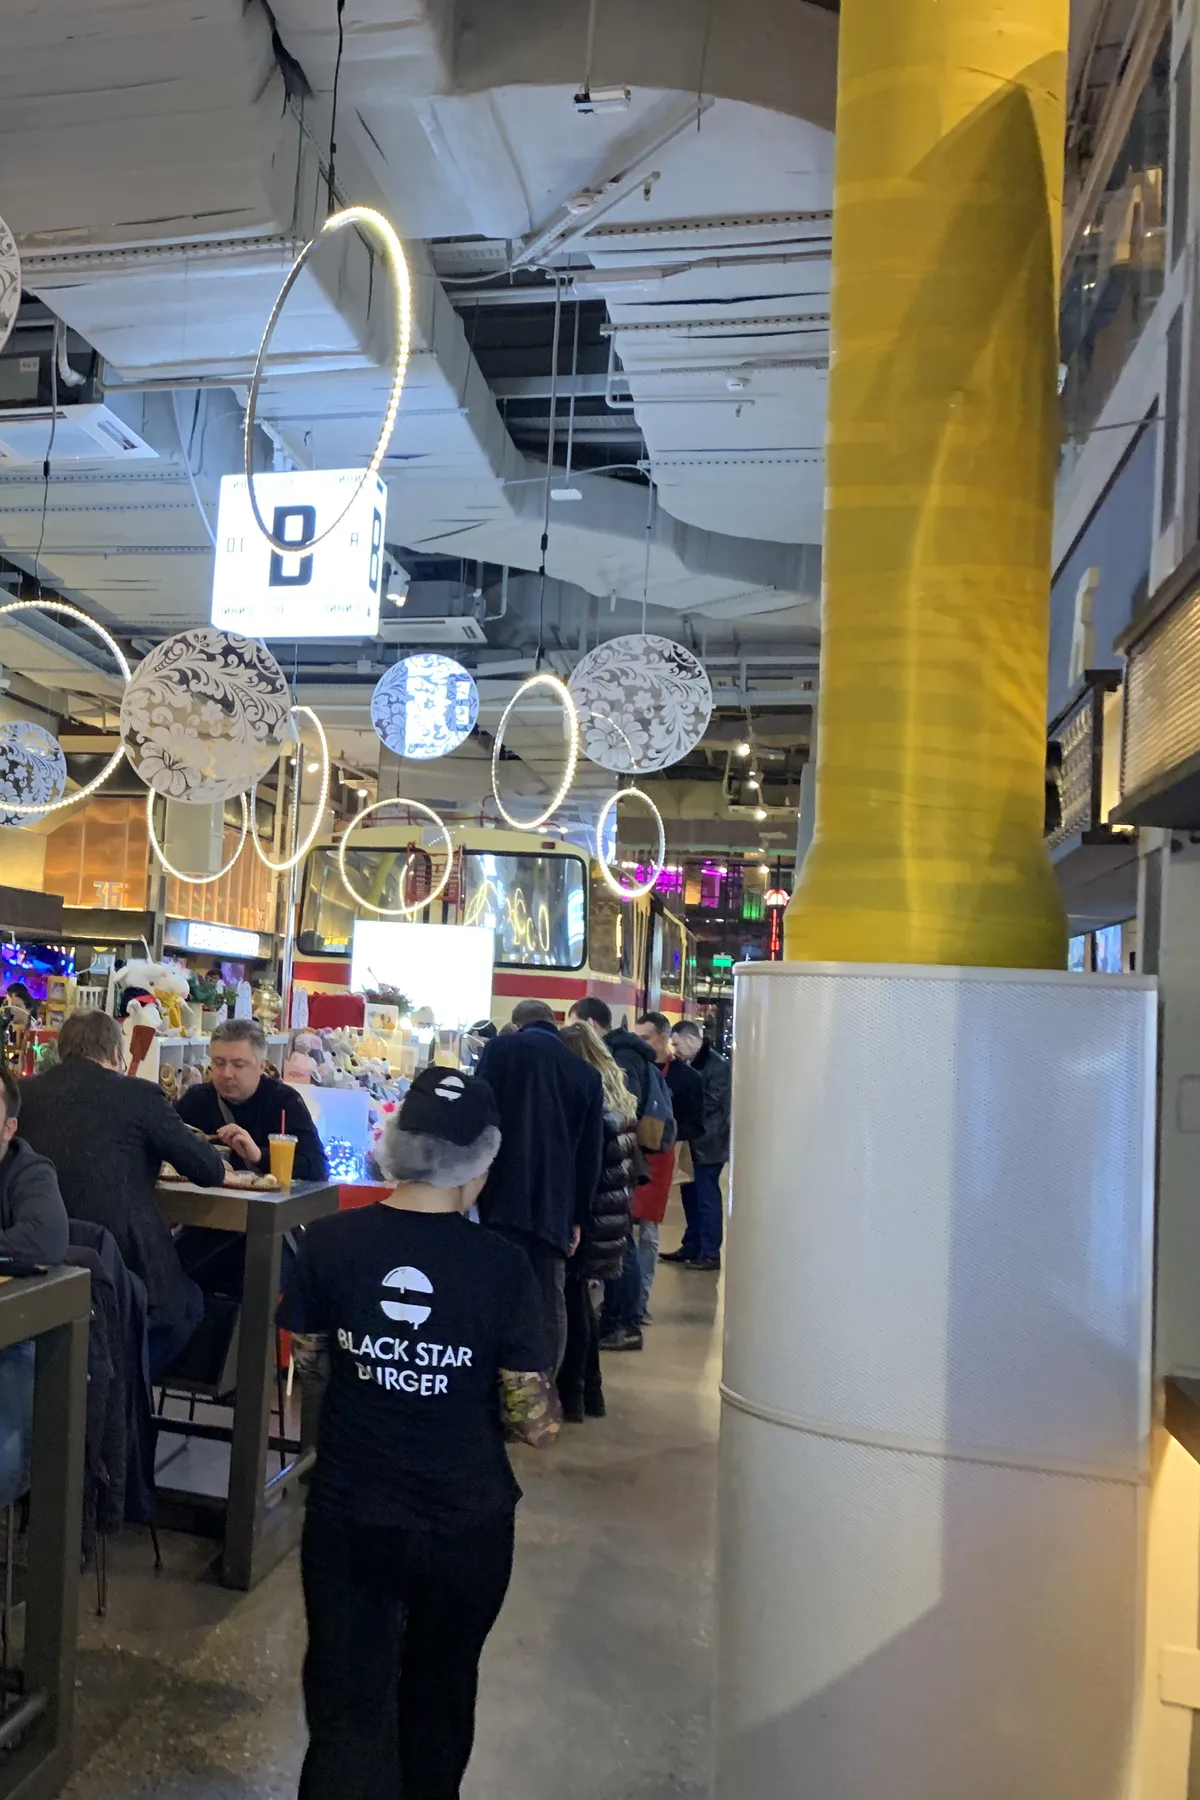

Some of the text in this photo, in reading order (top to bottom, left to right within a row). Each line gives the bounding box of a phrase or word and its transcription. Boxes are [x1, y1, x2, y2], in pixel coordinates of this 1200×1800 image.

[337, 1327, 473, 1368] BLACK STAR
[354, 1361, 449, 1397] BURGER
